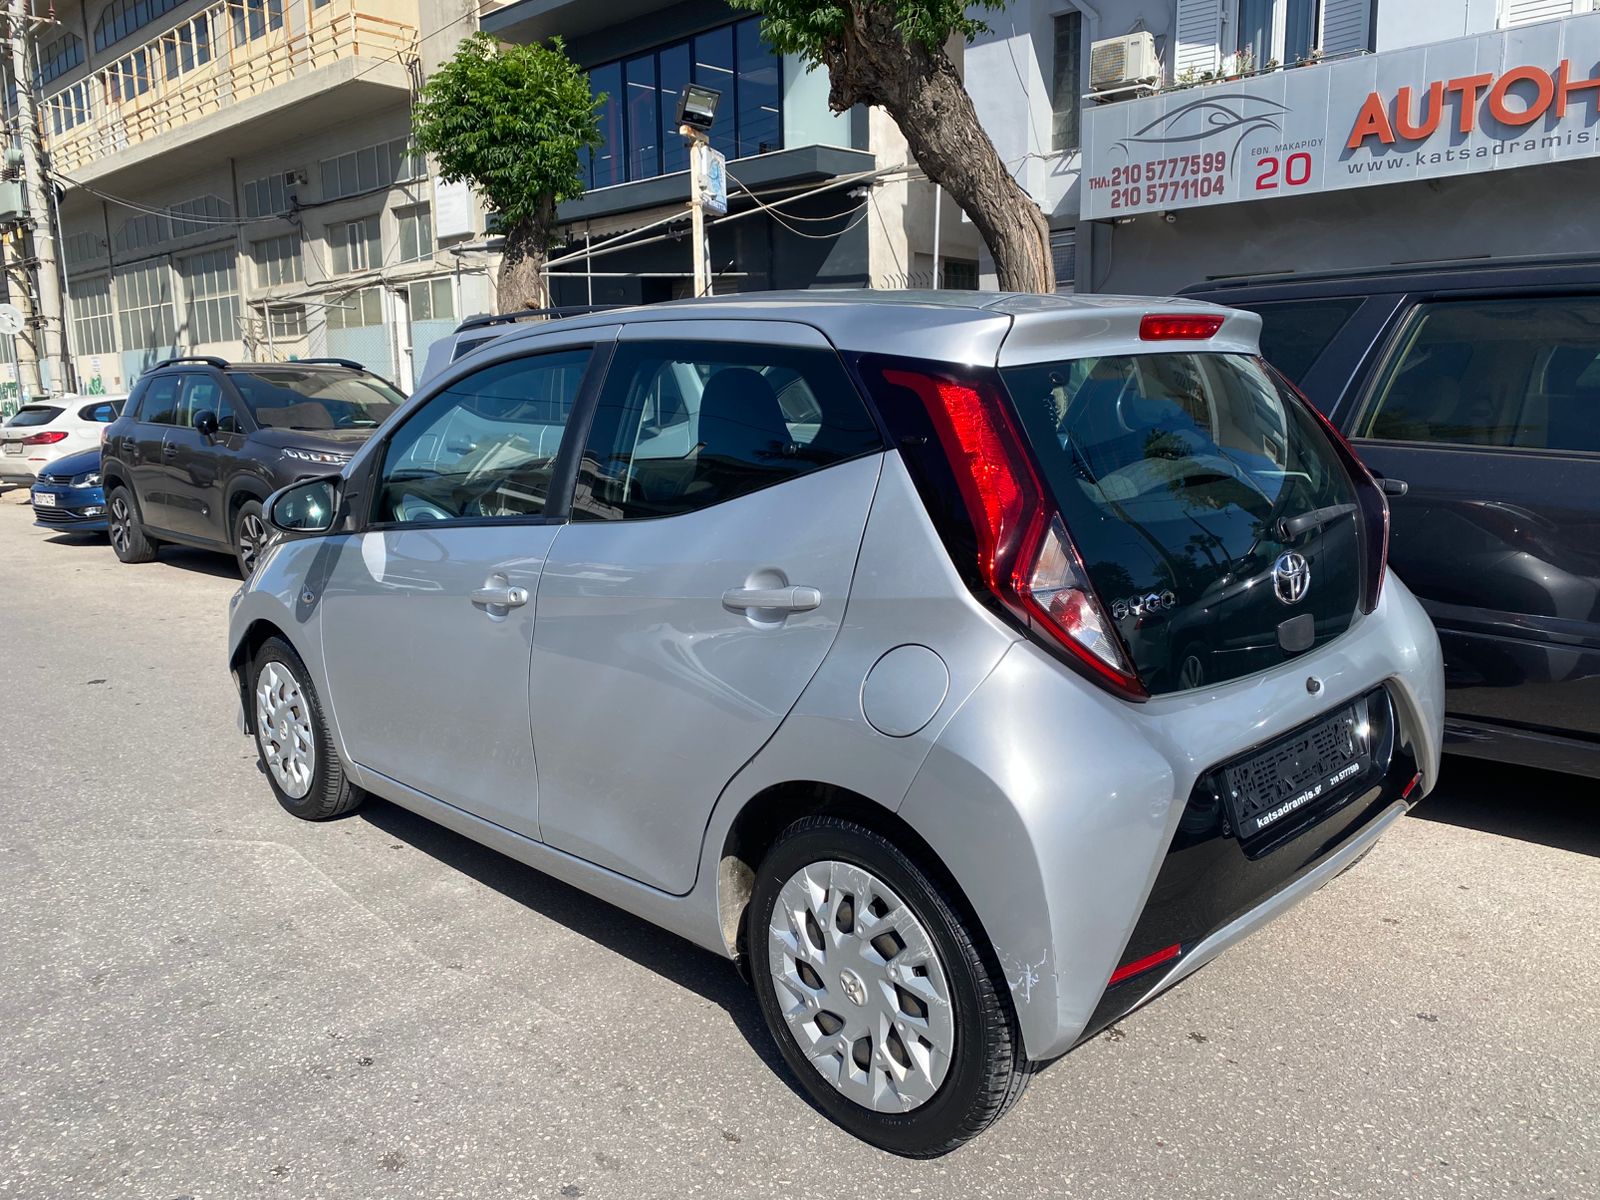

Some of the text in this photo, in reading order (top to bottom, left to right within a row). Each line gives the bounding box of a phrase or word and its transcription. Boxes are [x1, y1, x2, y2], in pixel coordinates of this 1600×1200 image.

[1274, 138, 1324, 153] ΜΑΚΑΡΙΟΥ
[1089, 151, 1226, 190] ΤΗΛ: 210 5777599
[1256, 152, 1311, 190] 20
[1111, 175, 1225, 209] 210 5771104
[1112, 590, 1176, 620] AYGO
[1256, 784, 1322, 828] katsadramis.gr
